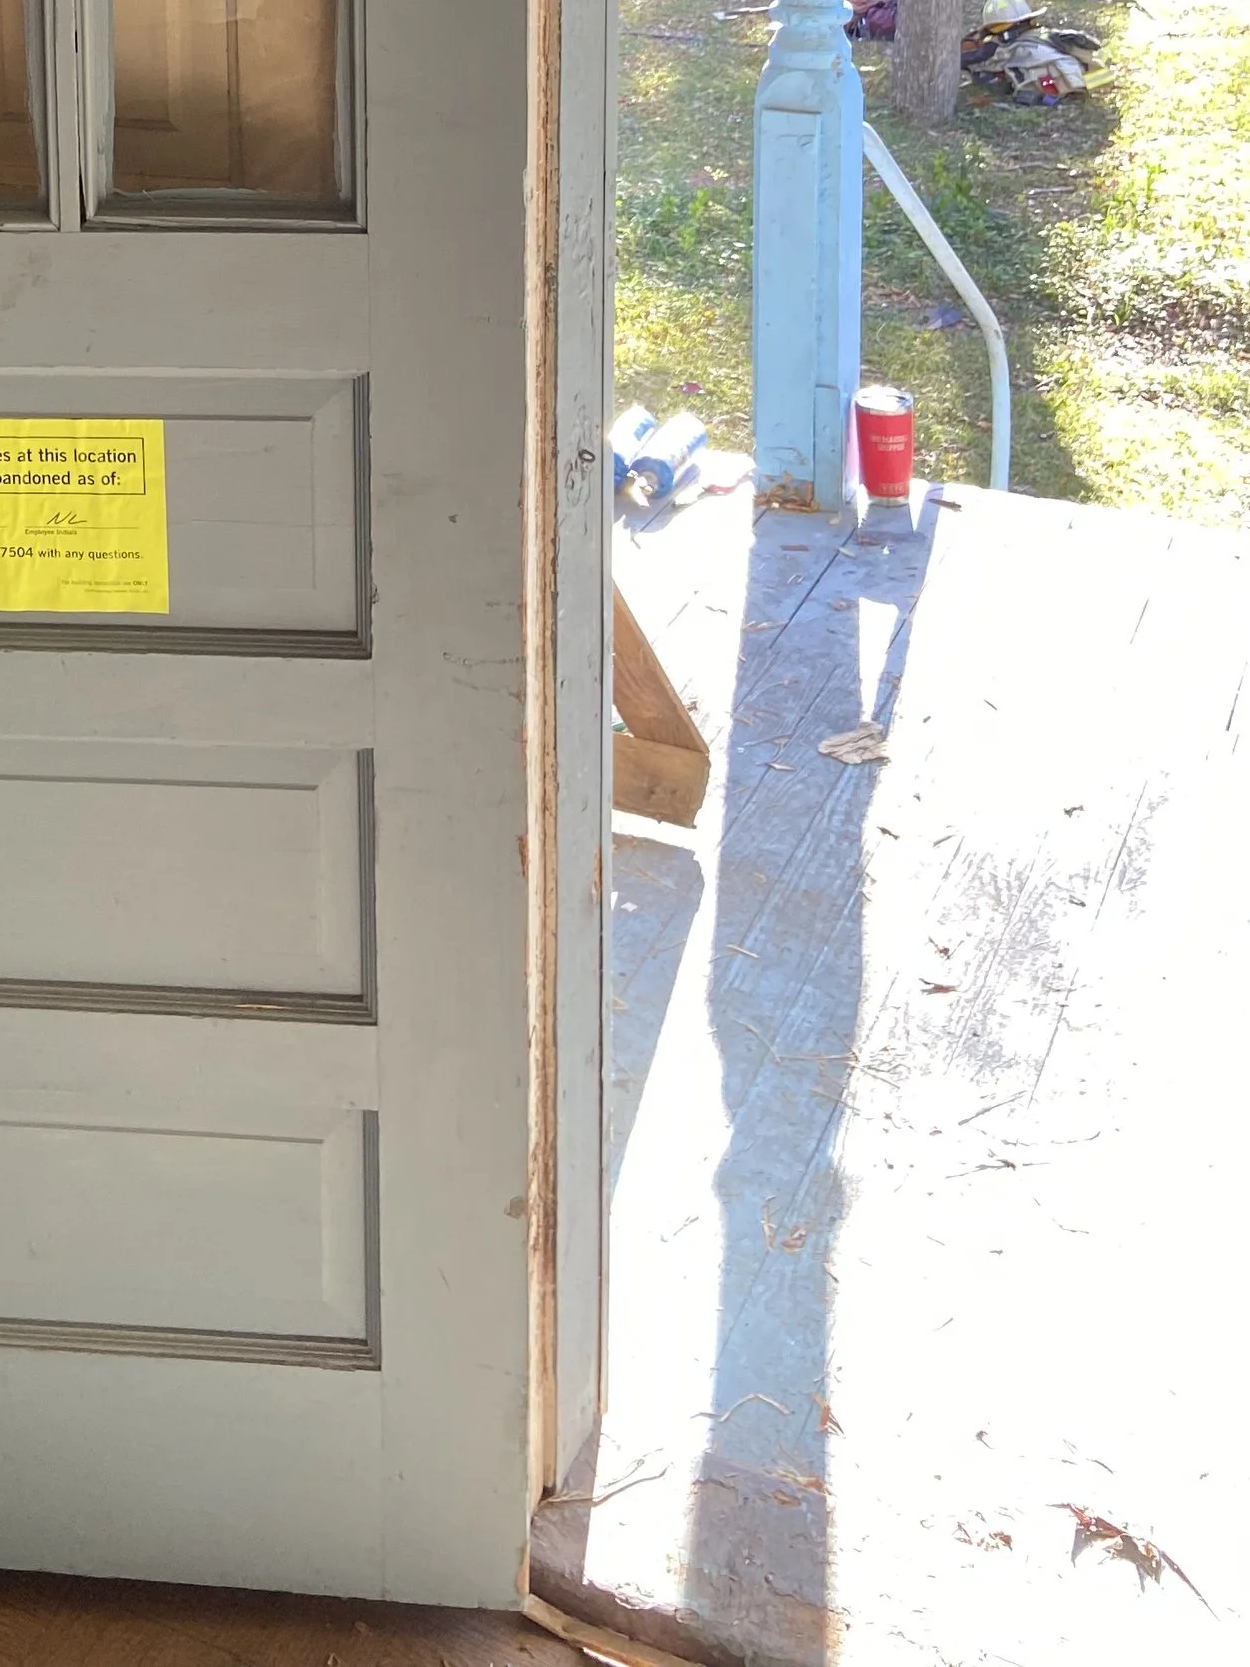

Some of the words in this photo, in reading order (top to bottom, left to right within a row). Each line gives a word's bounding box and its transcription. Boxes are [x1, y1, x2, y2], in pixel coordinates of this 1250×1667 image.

[17, 449, 32, 462] at
[38, 448, 68, 462] this
[74, 449, 137, 463] location
[77, 474, 95, 485] as
[101, 472, 122, 486] of:
[25, 529, 54, 537] Employee
[38, 548, 61, 558] with
[65, 550, 84, 561] any
[88, 549, 144, 562] questions.
